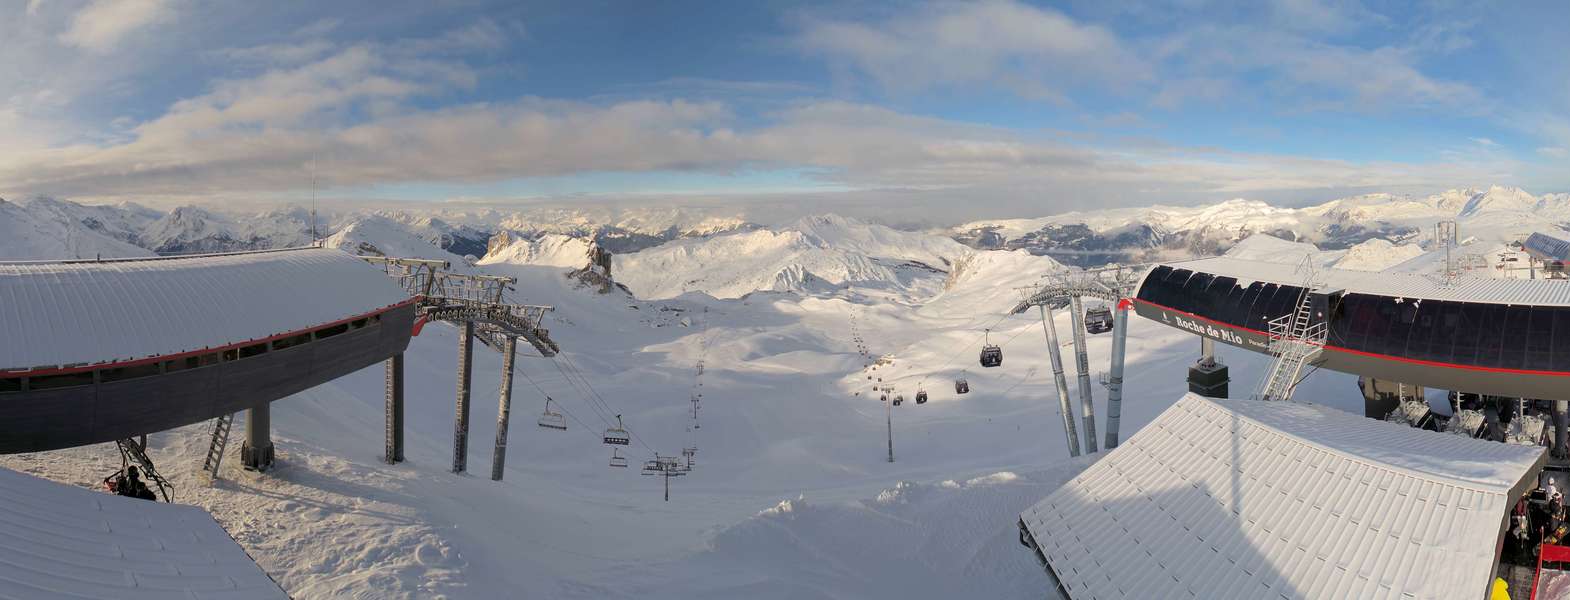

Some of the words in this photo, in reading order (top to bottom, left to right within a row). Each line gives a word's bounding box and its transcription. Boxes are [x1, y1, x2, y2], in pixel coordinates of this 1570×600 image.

[1175, 316, 1205, 334] Roche
[1206, 325, 1219, 338] de
[1220, 329, 1243, 345] Mio
